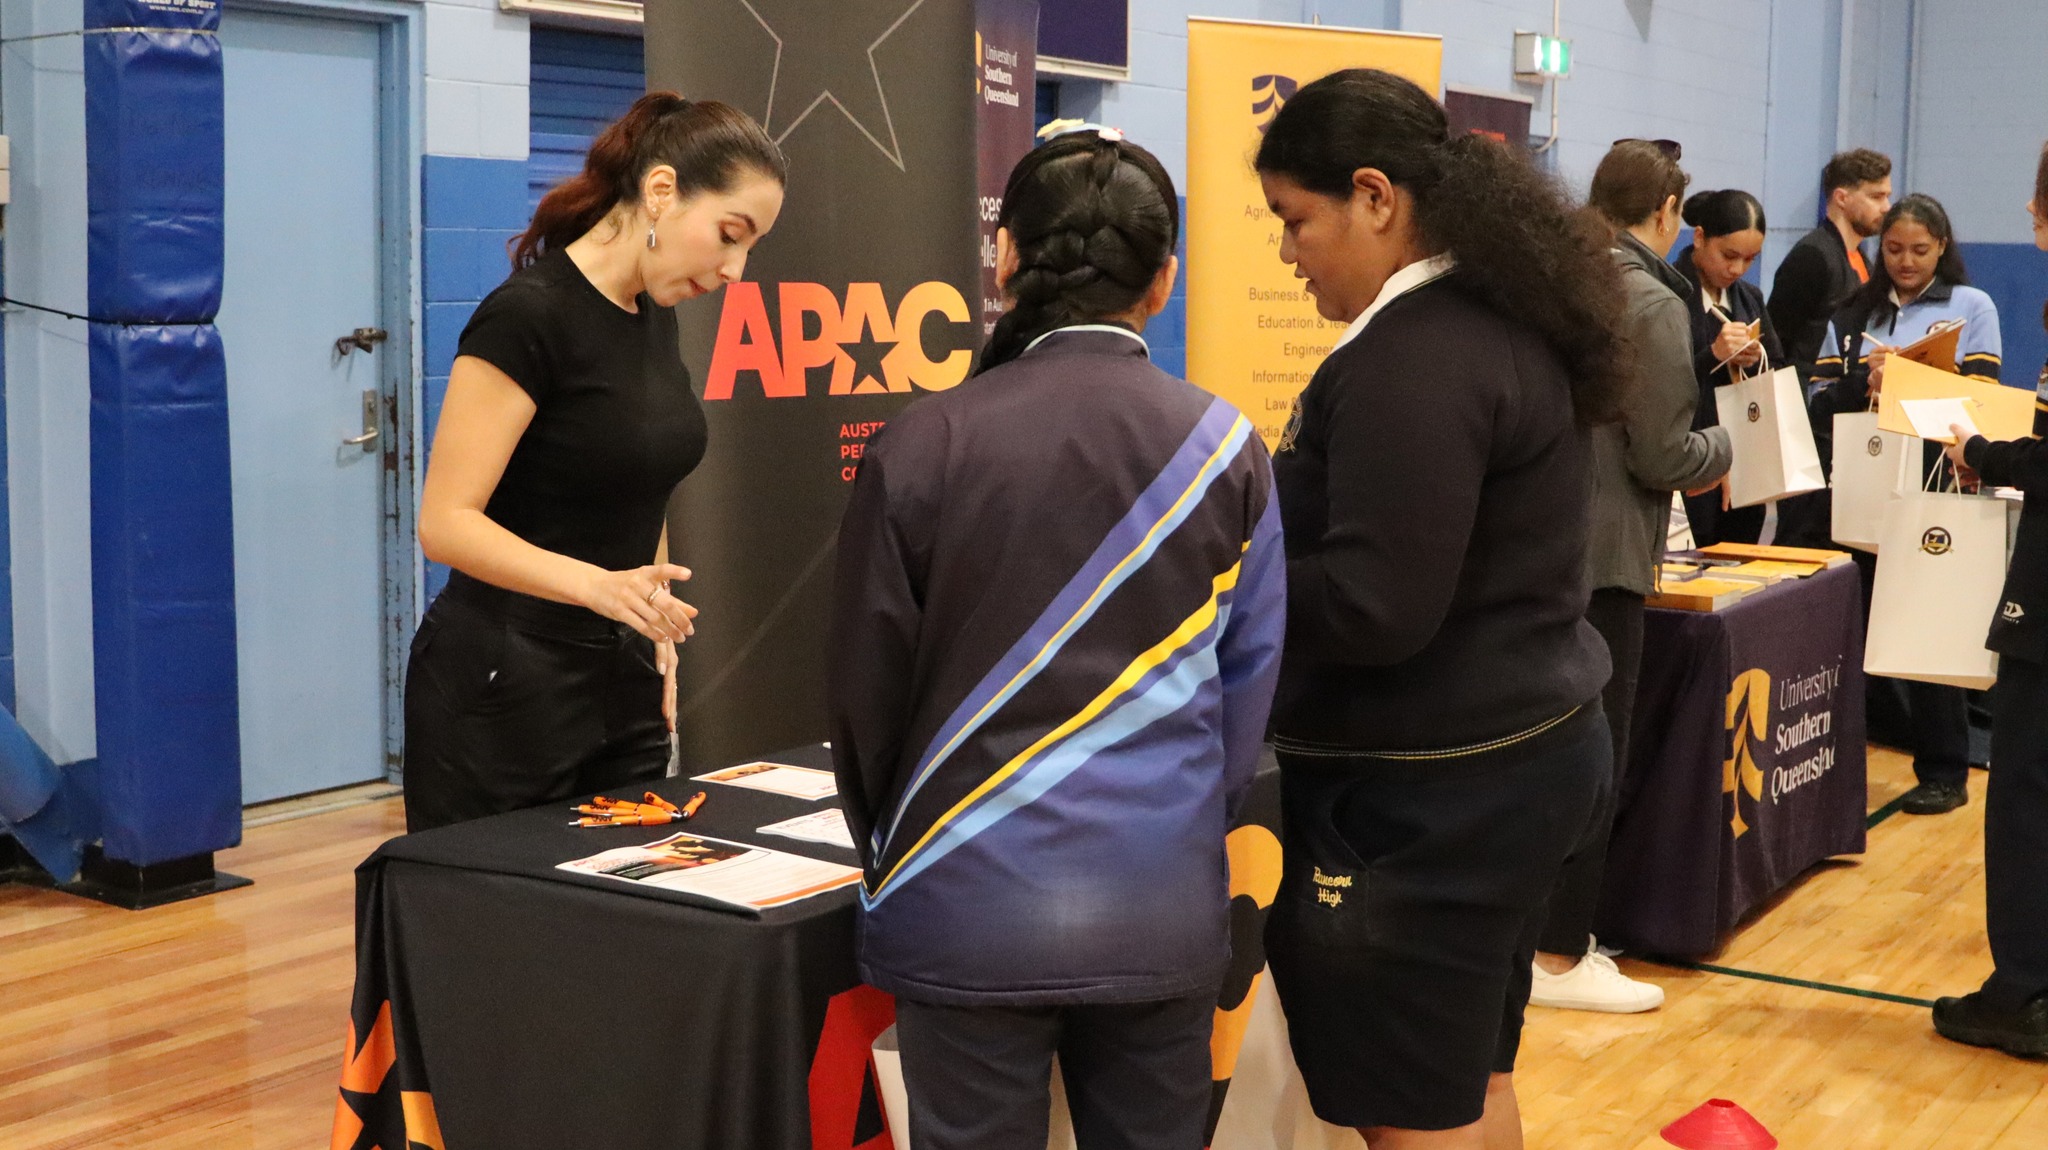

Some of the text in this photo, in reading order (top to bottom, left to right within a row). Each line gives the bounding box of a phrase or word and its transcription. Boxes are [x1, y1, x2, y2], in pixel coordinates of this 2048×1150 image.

[188, 0, 216, 9] SPORT
[984, 64, 1013, 86] Southern
[984, 85, 1019, 107] Queensland
[979, 196, 1003, 222] ces
[981, 234, 997, 268] lle
[1249, 287, 1310, 302] Business &
[1258, 315, 1314, 329] Education
[1316, 316, 1325, 329] &
[703, 280, 973, 400] APAC
[1265, 397, 1288, 411] Law
[1253, 424, 1280, 438] edia
[1779, 664, 1834, 711] University
[1774, 710, 1831, 755] Southern
[1317, 887, 1343, 907] High
